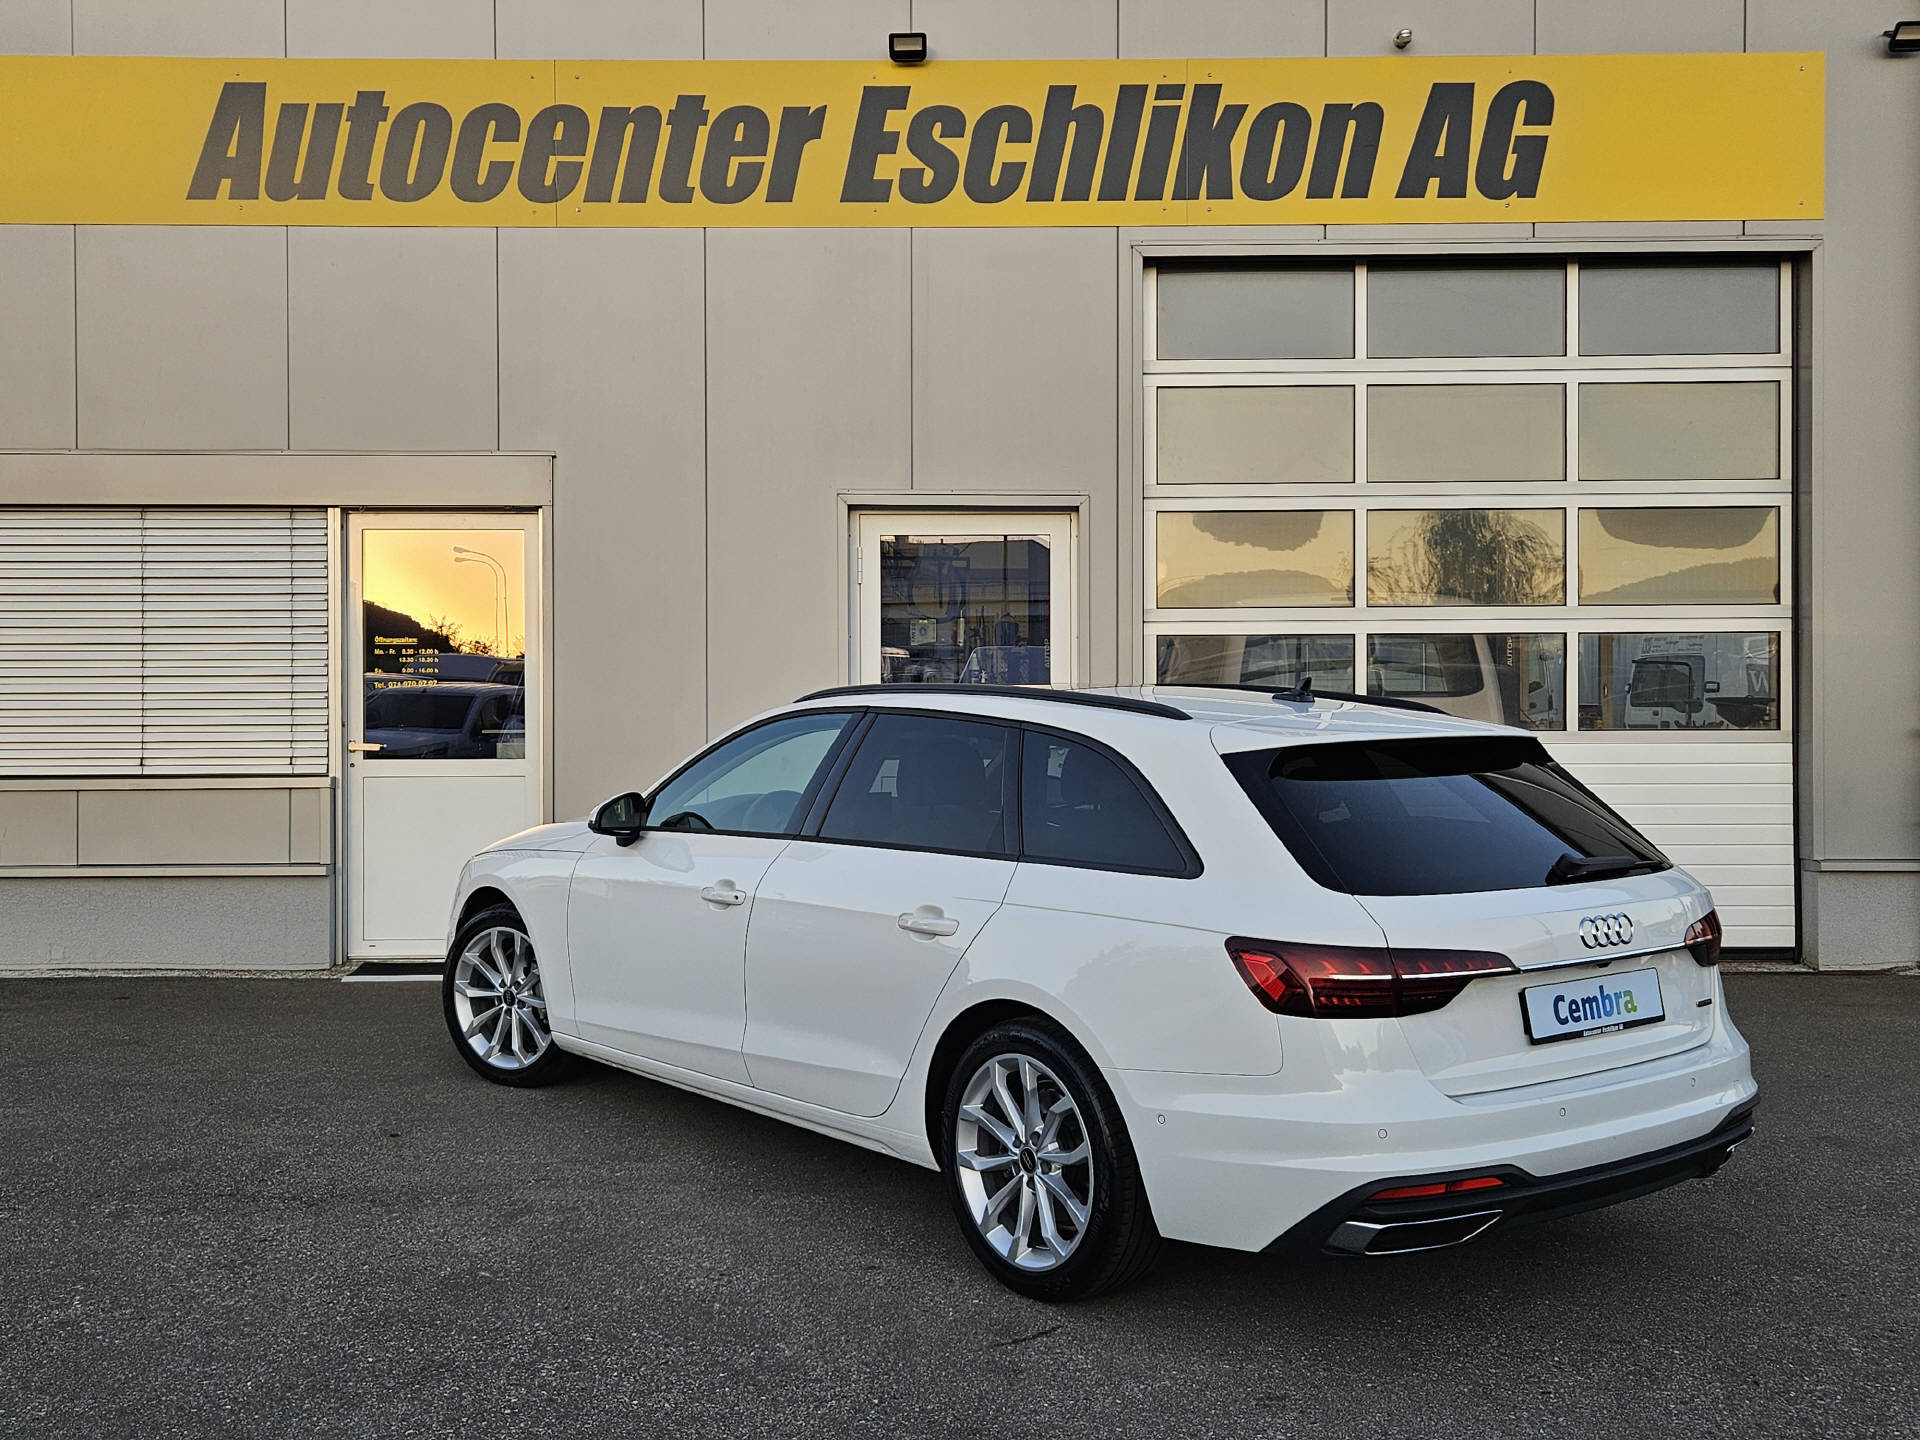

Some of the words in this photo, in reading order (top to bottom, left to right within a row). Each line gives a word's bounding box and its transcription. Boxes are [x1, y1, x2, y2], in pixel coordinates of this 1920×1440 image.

[186, 82, 827, 204] Autocenter
[840, 83, 1384, 204] Eschlikon
[1395, 80, 1556, 200] AG
[1553, 985, 1638, 1025] Cembra
